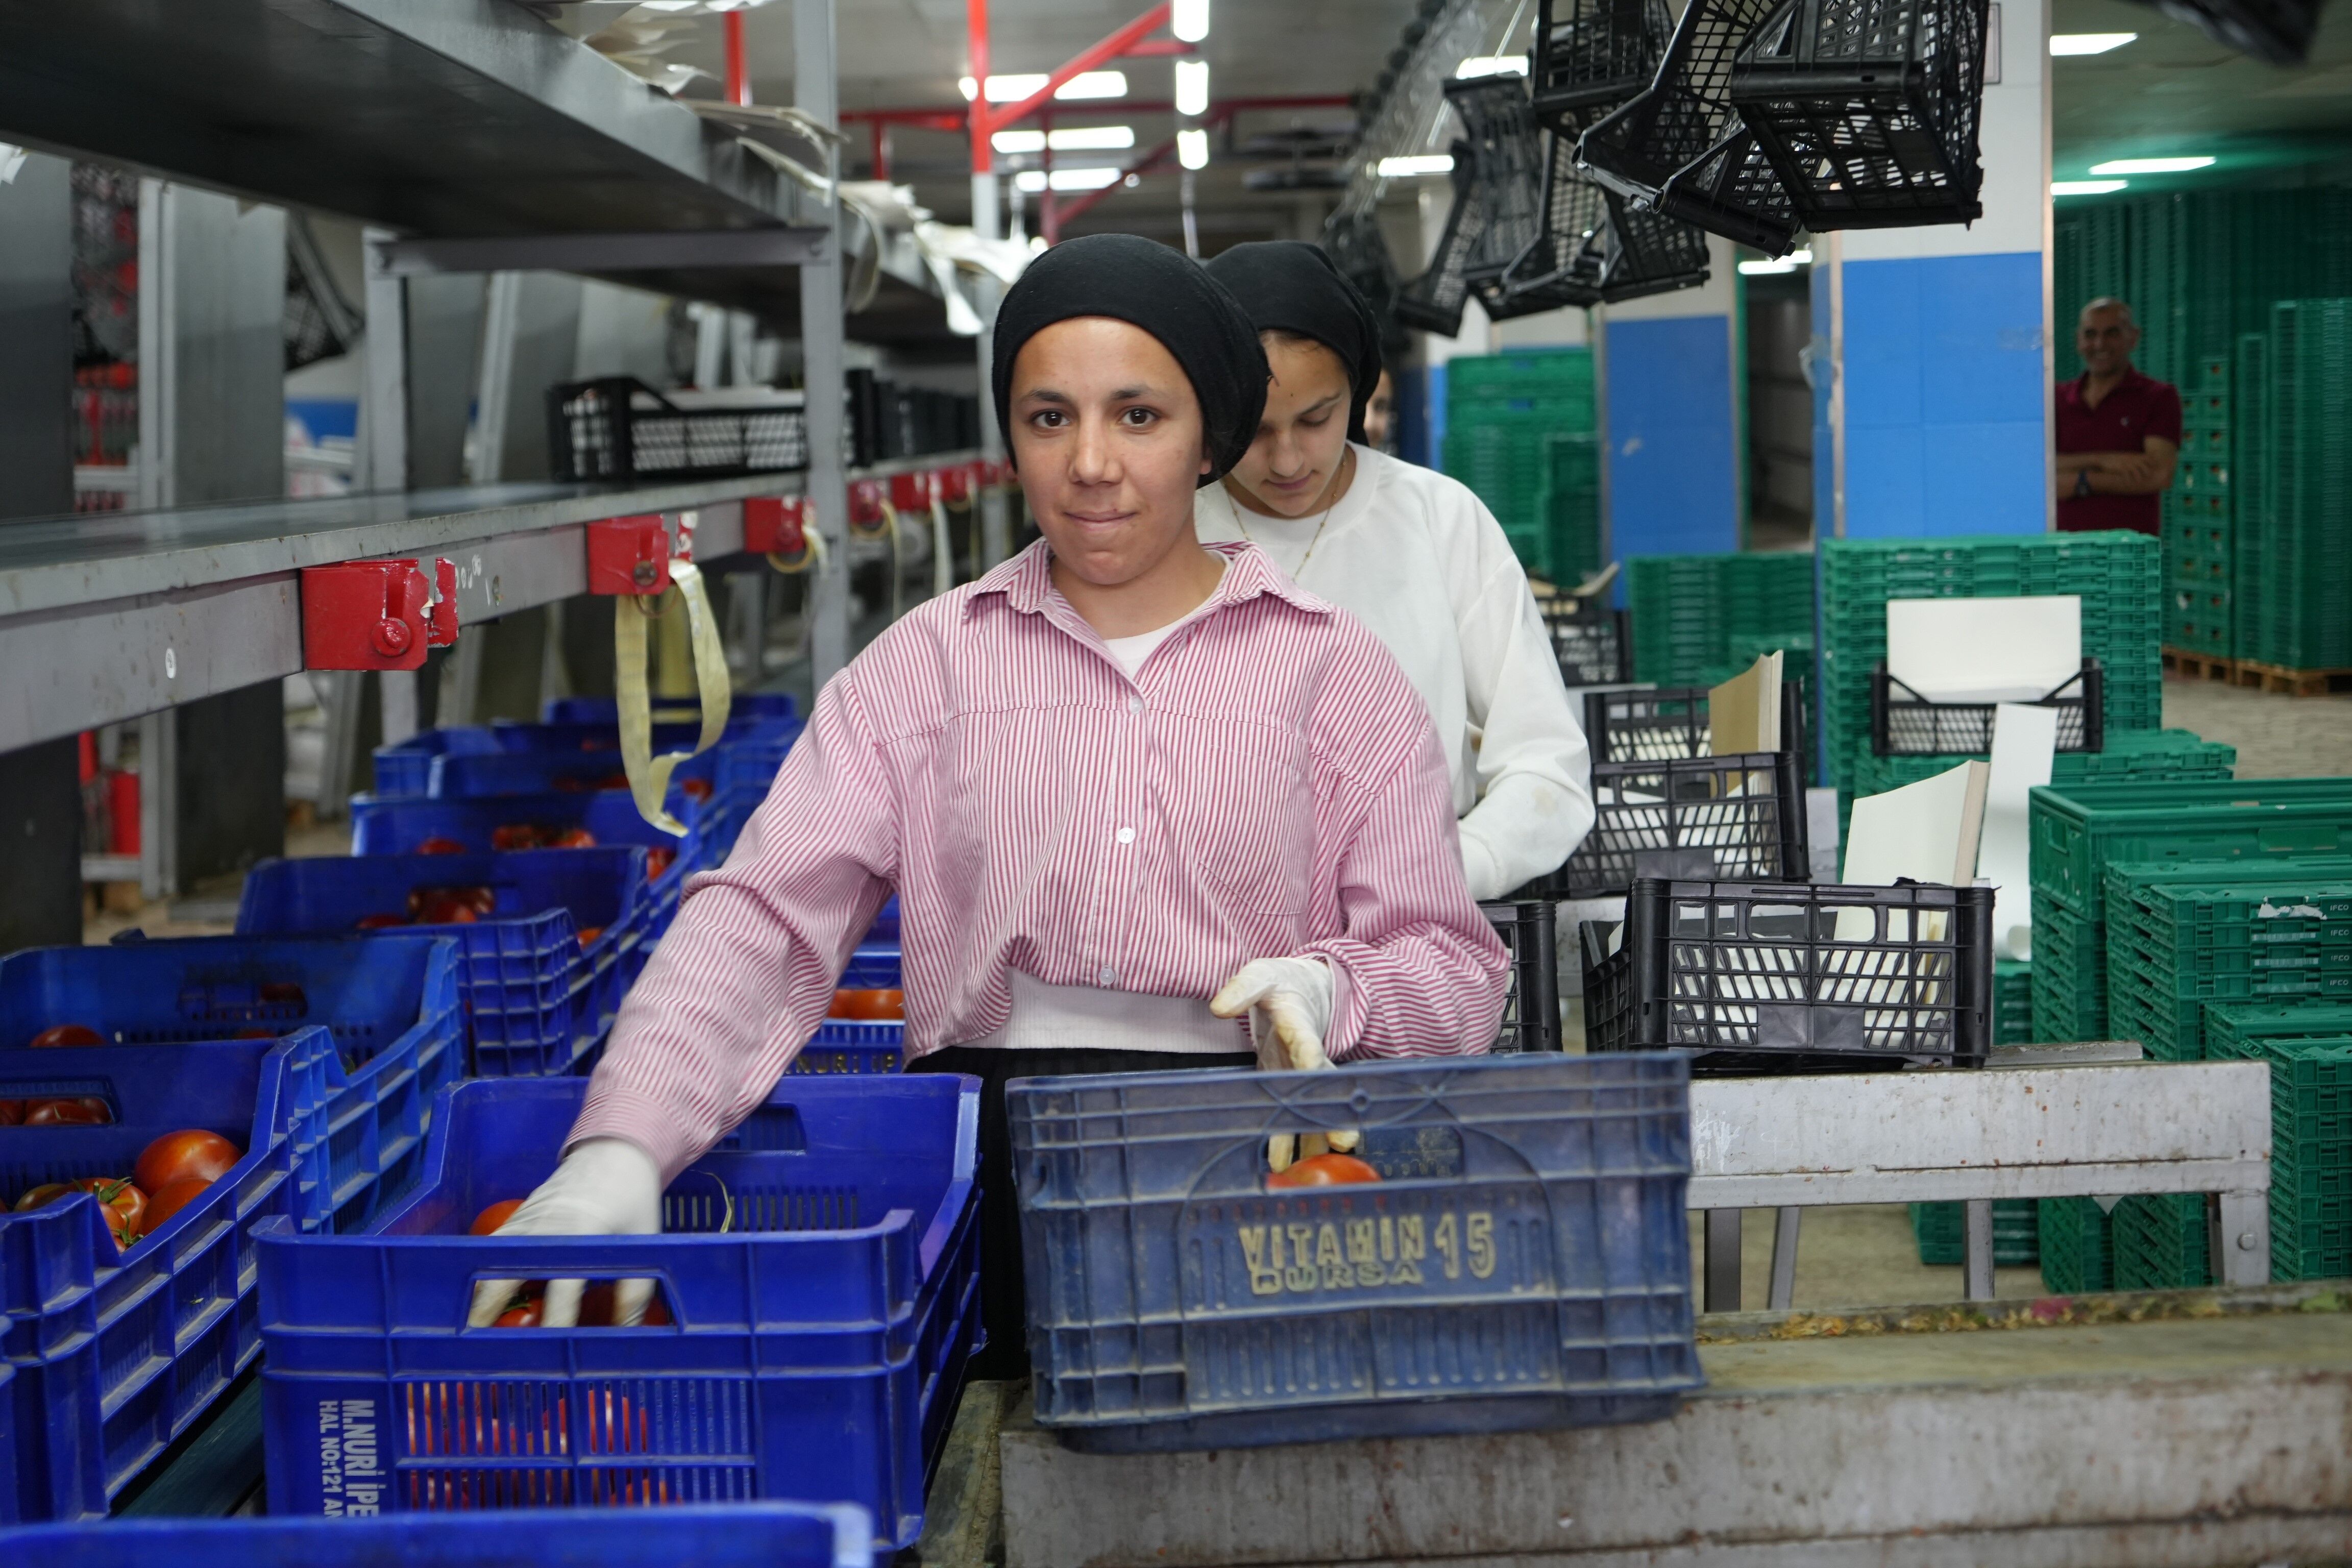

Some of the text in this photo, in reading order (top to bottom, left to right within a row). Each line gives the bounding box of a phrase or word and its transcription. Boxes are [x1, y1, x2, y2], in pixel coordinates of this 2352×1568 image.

[1434, 1211, 1497, 1279] 15
[319, 1401, 339, 1434] HAL
[321, 1437, 342, 1493] NO:121
